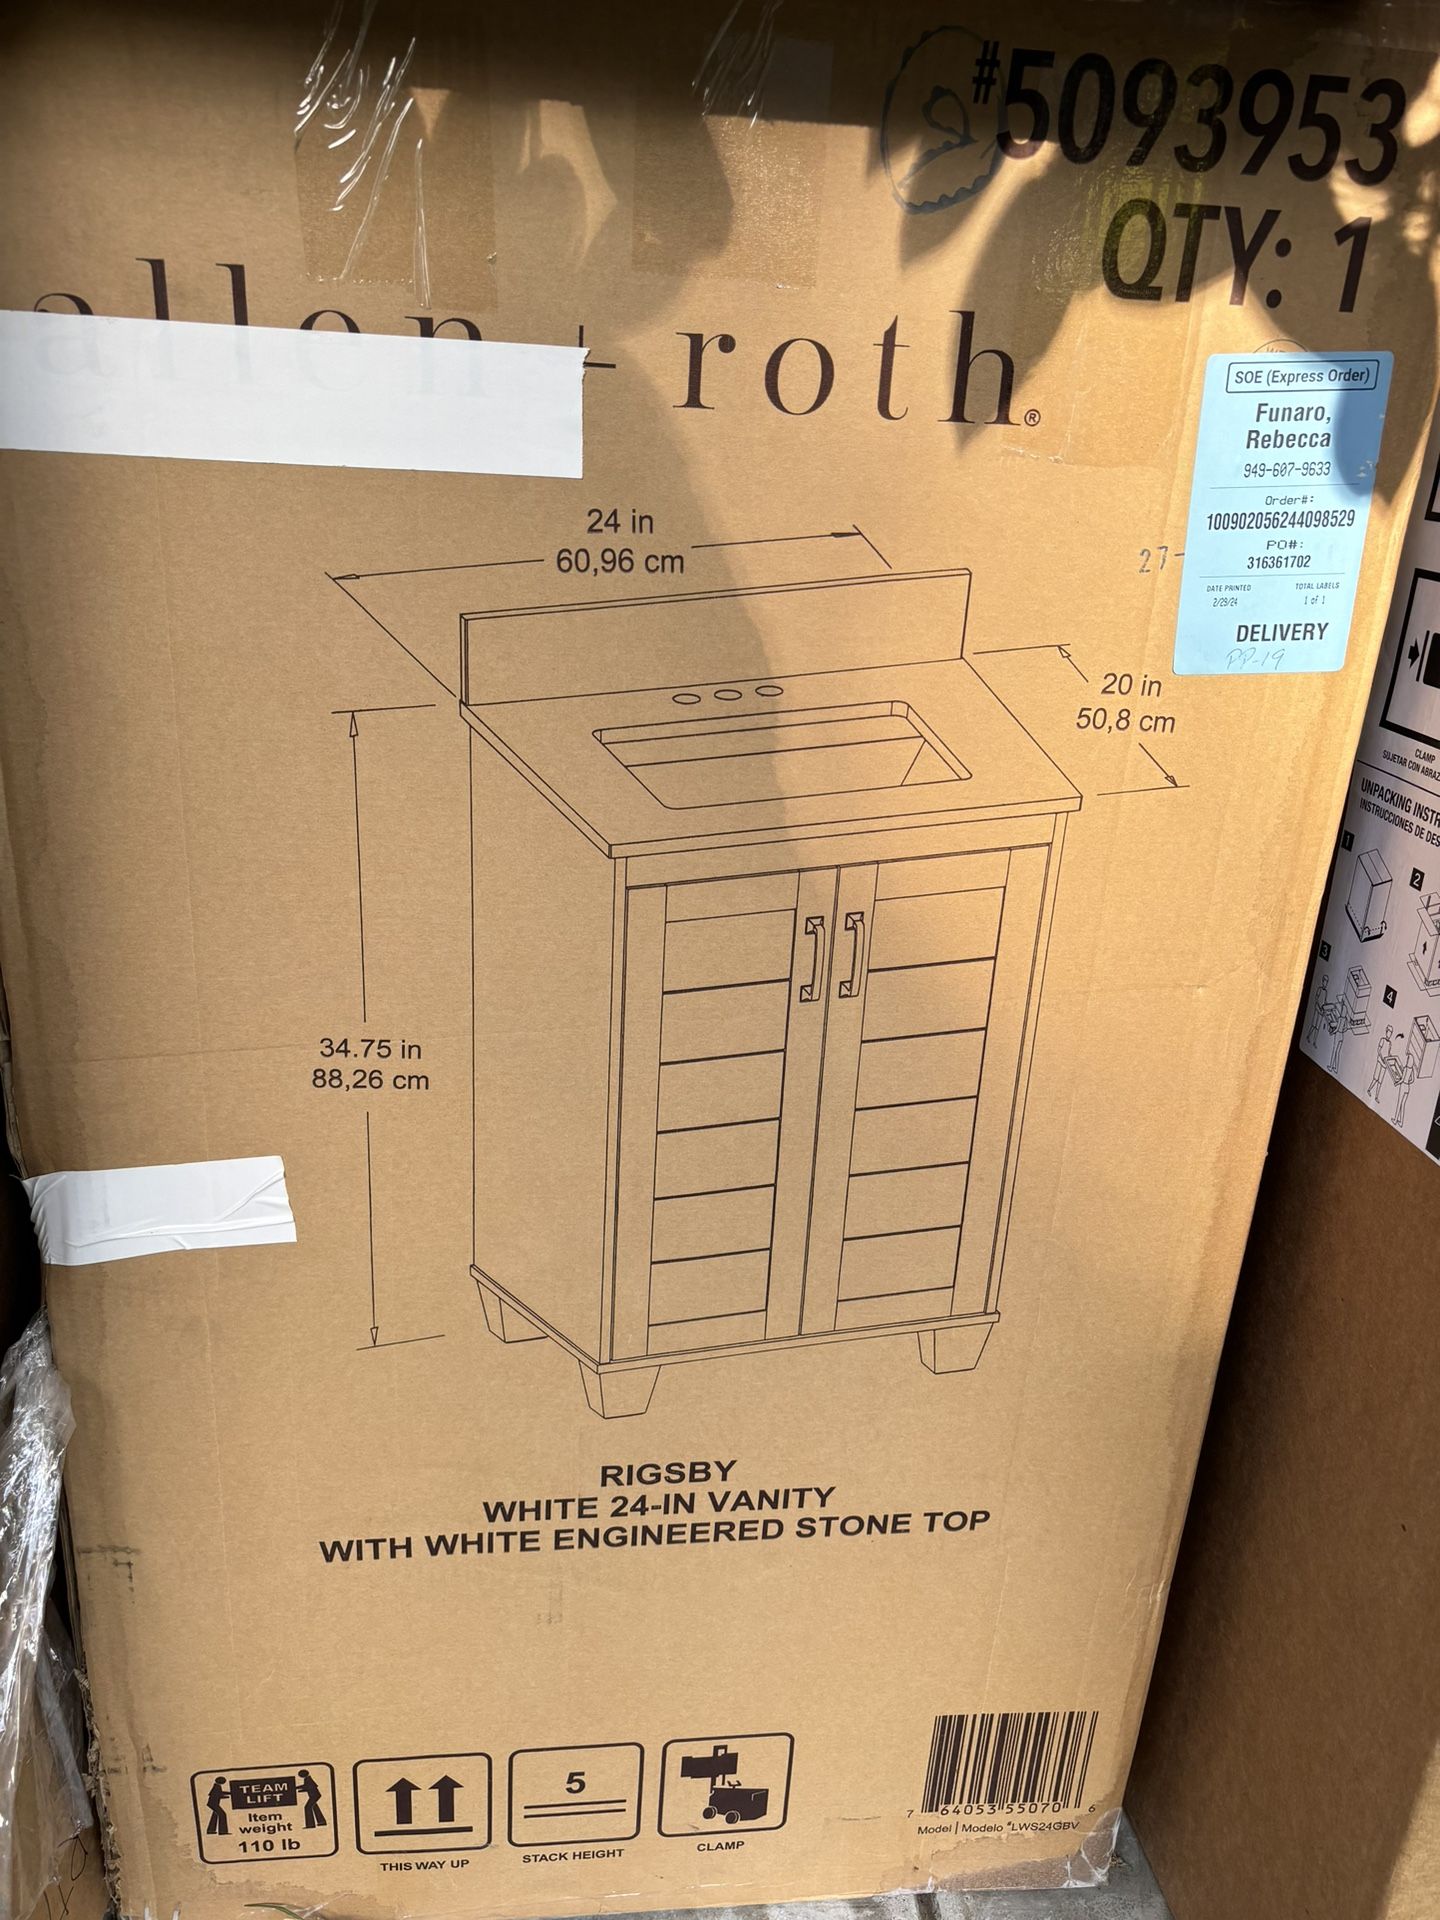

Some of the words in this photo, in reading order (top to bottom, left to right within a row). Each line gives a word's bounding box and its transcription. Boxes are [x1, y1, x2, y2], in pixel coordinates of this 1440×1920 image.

[973, 40, 1407, 186] #5093953
[1102, 199, 1292, 308] QTY:
[1333, 217, 1373, 313] 1
[1234, 370, 1263, 384] SOE
[1266, 369, 1324, 387] (Express
[1328, 368, 1371, 383] Order)
[1255, 402, 1332, 424] Funaro,
[1245, 429, 1332, 450] Rebecca
[1243, 461, 1332, 478] 949-607-9633
[1265, 495, 1315, 506] Order#:
[586, 508, 621, 534] 24
[631, 508, 654, 534] in
[1206, 509, 1356, 531] 100902056244098529
[1266, 540, 1304, 550] PO#:
[555, 548, 635, 577] 60,96
[644, 553, 685, 574] cm
[1247, 555, 1312, 570] 316361702
[1206, 584, 1223, 593] DATE
[1224, 583, 1252, 592] PRINTED
[1295, 582, 1314, 590] TOTAL
[1316, 581, 1340, 590] LABELS
[1236, 621, 1330, 643] DELIVERY
[1101, 672, 1133, 695] 20
[1140, 674, 1162, 697] in
[1076, 707, 1131, 734] 50,8
[1139, 714, 1176, 733] cm
[1382, 750, 1408, 768] SUJETAR
[1407, 760, 1421, 773] CON
[1414, 748, 1436, 764] CLAMP
[1360, 777, 1413, 814] UNPACKING
[1359, 797, 1414, 834] INSTRUCCIONES
[1414, 824, 1426, 840] DE
[1412, 872, 1423, 888] 2
[319, 1037, 392, 1059] 34.75
[401, 1039, 422, 1060] in
[311, 1068, 384, 1092] 88,26
[392, 1073, 430, 1090] cm
[600, 1459, 738, 1488] RIGSBY
[483, 1499, 598, 1524] WHITE
[610, 1493, 695, 1518] 24-IN
[707, 1486, 837, 1512] VANITY
[319, 1535, 414, 1563] WITH
[424, 1530, 542, 1557] WHITE
[553, 1518, 785, 1551] ENGINEERED
[795, 1512, 912, 1538] STONE
[922, 1509, 991, 1532] TOP
[239, 1782, 289, 1794] TEAM
[565, 1771, 586, 1795] 5
[245, 1793, 284, 1805] LIFT
[248, 1811, 283, 1823] Item
[906, 1809, 914, 1819] 7
[1005, 1802, 1061, 1815] 55070
[1088, 1803, 1096, 1813] 6
[238, 1822, 293, 1835] weight
[917, 1824, 952, 1835] Model
[961, 1822, 1004, 1833] Modelo
[238, 1839, 275, 1854] 110
[282, 1838, 301, 1852] lb
[696, 1840, 745, 1852] CLAMP
[380, 1861, 413, 1872] THIS
[415, 1860, 446, 1871] WAY
[450, 1858, 470, 1869] UP
[522, 1852, 568, 1864] STACK
[572, 1849, 625, 1861] HEIGHT
